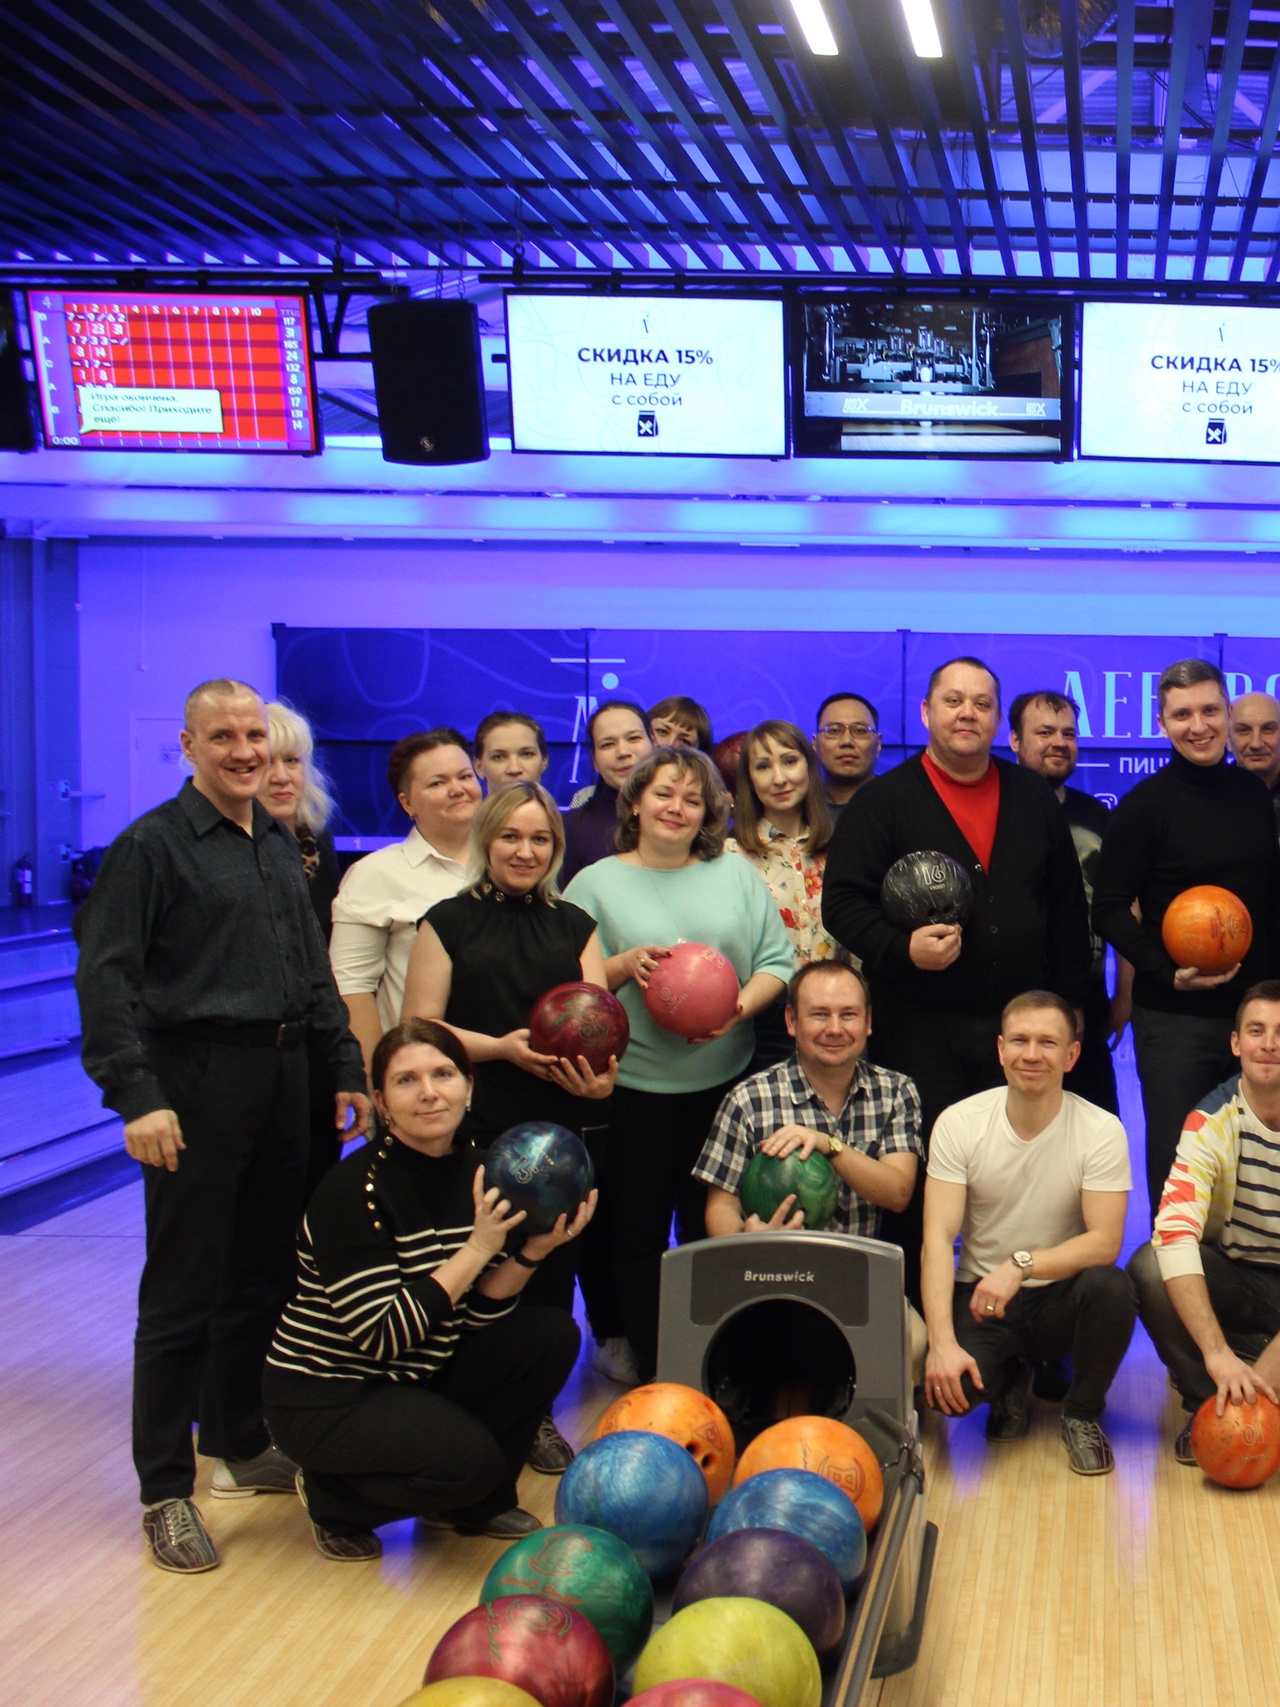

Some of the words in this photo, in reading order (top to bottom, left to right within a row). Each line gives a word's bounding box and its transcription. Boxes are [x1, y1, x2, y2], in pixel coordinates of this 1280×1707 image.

[92, 303, 99, 313] 2
[112, 303, 120, 313] 3
[132, 305, 140, 314] 4
[152, 305, 160, 314] 5
[172, 306, 180, 315] 6
[192, 306, 199, 315] 7
[212, 306, 220, 316] 8
[232, 307, 240, 316] 9
[250, 307, 262, 317] 10
[283, 317, 296, 326] 117
[75, 323, 82, 334] 7
[91, 323, 105, 335] 23
[111, 323, 124, 335] 31
[285, 327, 295, 338] 31
[76, 345, 85, 357] 8
[94, 346, 107, 358] 14
[285, 350, 299, 361] 24
[577, 347, 669, 365] СКИДКА
[676, 349, 714, 365] 15%
[285, 363, 300, 372] 132
[1150, 355, 1242, 374] СКИДКА
[99, 370, 108, 381] 8
[290, 374, 298, 385] 8
[610, 372, 637, 386] НА
[643, 373, 681, 388] ЕДУ
[287, 386, 302, 395] 150
[1182, 380, 1209, 393] НА
[1215, 381, 1253, 396] ЕДУ
[91, 393, 118, 402] Игра
[121, 394, 179, 402] окончена.
[290, 397, 301, 408] 17
[611, 395, 621, 405] с
[627, 392, 683, 406] собой
[92, 404, 146, 413] Спасибо!
[150, 406, 212, 415] Приходите
[900, 399, 1000, 417] Brunswick
[1182, 403, 1191, 413] с
[1197, 400, 1253, 414] собой
[93, 415, 120, 424] ещё!
[292, 419, 303, 430] 14
[52, 436, 79, 445] 0:00
[743, 1270, 816, 1282] Brunswick
